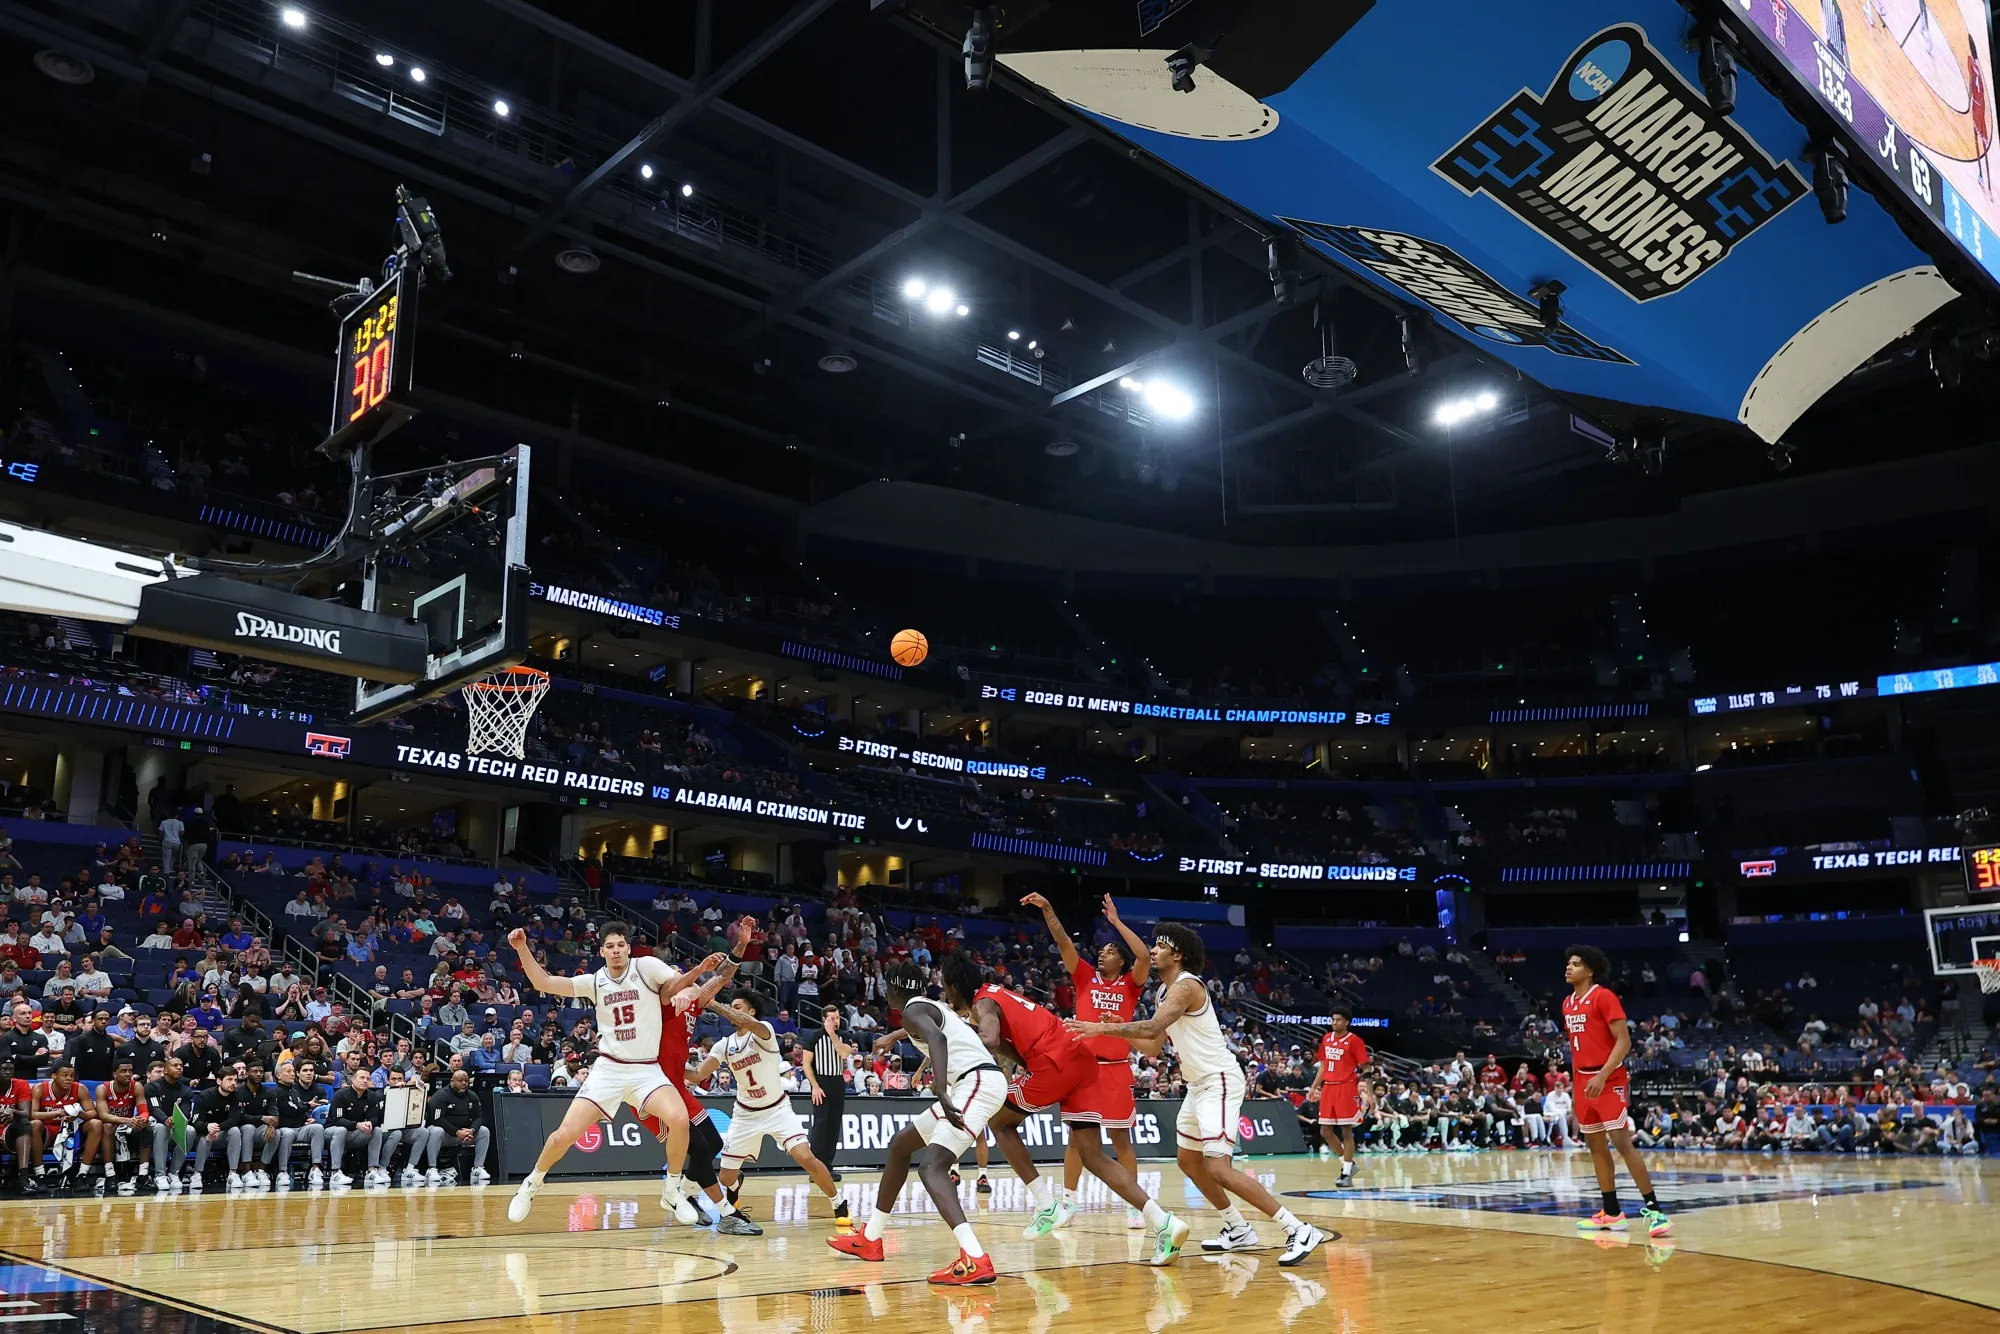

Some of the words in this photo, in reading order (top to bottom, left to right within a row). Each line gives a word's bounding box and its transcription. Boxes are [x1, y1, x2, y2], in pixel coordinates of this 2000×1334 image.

[1576, 60, 1614, 96] NCAA
[1816, 57, 1853, 123] 13:23
[1586, 68, 1744, 200] MARCH
[1910, 148, 1933, 206] 63
[1540, 141, 1723, 285] MADNESS
[350, 339, 391, 422] 30
[235, 612, 340, 654] SPALDING
[583, 684, 595, 694] 202
[1728, 693, 1755, 709] ILLST
[1760, 691, 1775, 705] 78
[1816, 685, 1831, 698] 75
[1840, 681, 1859, 696] WF
[1025, 690, 1063, 706] 2026
[1067, 695, 1084, 708] DI
[1087, 697, 1130, 713] MEN'S
[1134, 703, 1221, 721] BASKETBALL
[1225, 709, 1346, 724] CHAMPIONSHIP
[1694, 697, 1717, 707] NCAA
[1697, 705, 1716, 713] MEN
[856, 740, 897, 759] FIRST
[912, 751, 963, 771] SECOND
[967, 761, 1028, 778] ROUNDS
[397, 745, 461, 770] TEXAS
[467, 756, 516, 778] TECH
[521, 765, 559, 784] RED
[564, 771, 644, 796] RAIDERS
[652, 786, 670, 800] VS
[675, 788, 752, 813] ALABAMA
[757, 800, 827, 824] CRIMSON
[832, 811, 866, 830] TIDE
[1813, 854, 1869, 869] TEXAS
[1875, 850, 1922, 865] TECH
[1198, 859, 1243, 875] FIRST
[1260, 863, 1323, 880] SECOND
[1328, 866, 1397, 881] ROUNDS
[603, 989, 640, 1006] CRIMSON
[1091, 989, 1124, 1002] TEXAS
[1092, 999, 1119, 1011] TECH
[612, 1004, 636, 1027] 15
[1565, 1014, 1586, 1024] TEXAS
[614, 1027, 637, 1041] TIDE
[1573, 1035, 1580, 1051] 4
[731, 1053, 762, 1071] CRIMSON
[1328, 1061, 1334, 1072] 11
[746, 1069, 757, 1086] 1
[746, 1086, 767, 1098] TIDE
[607, 1122, 641, 1146] LG
[1253, 1118, 1275, 1136] LG
